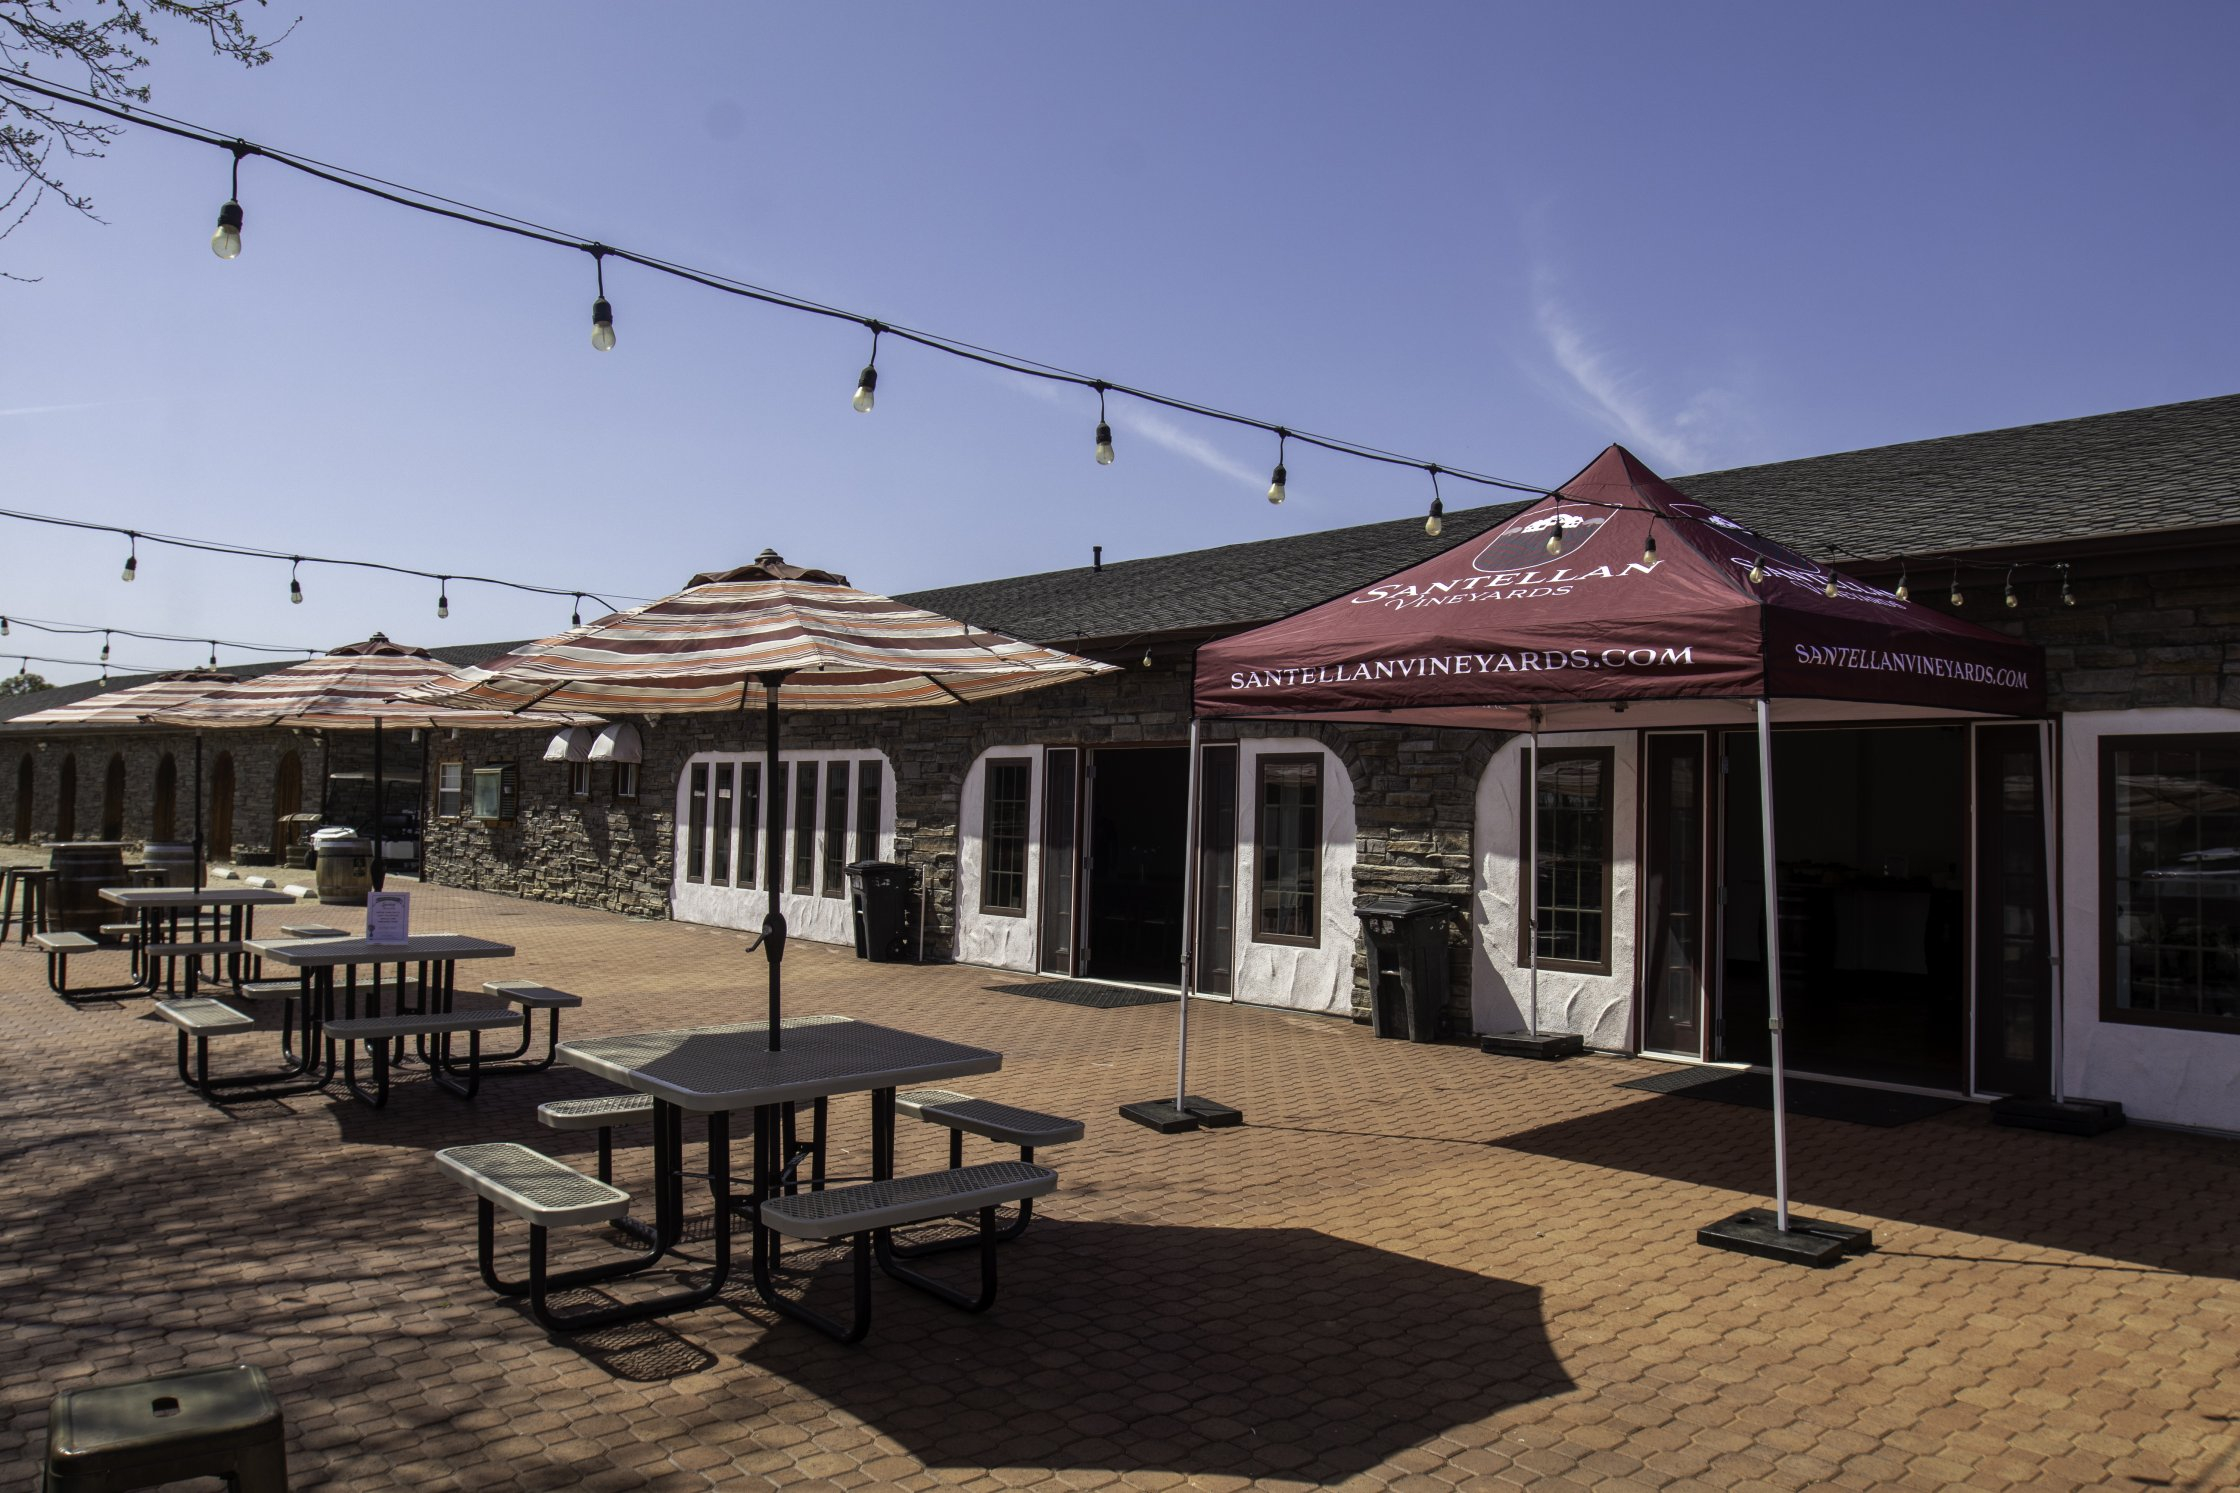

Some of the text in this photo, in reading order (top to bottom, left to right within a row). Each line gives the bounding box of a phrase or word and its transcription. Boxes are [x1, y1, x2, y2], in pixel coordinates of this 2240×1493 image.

[1351, 560, 1664, 604] SANTELLAN
[1385, 585, 1574, 610] VINEYARDS
[1230, 646, 1695, 690] SANTELLANVINEYARDS.COM
[1795, 643, 2029, 689] SANTELLANVINEYARDS.COM
